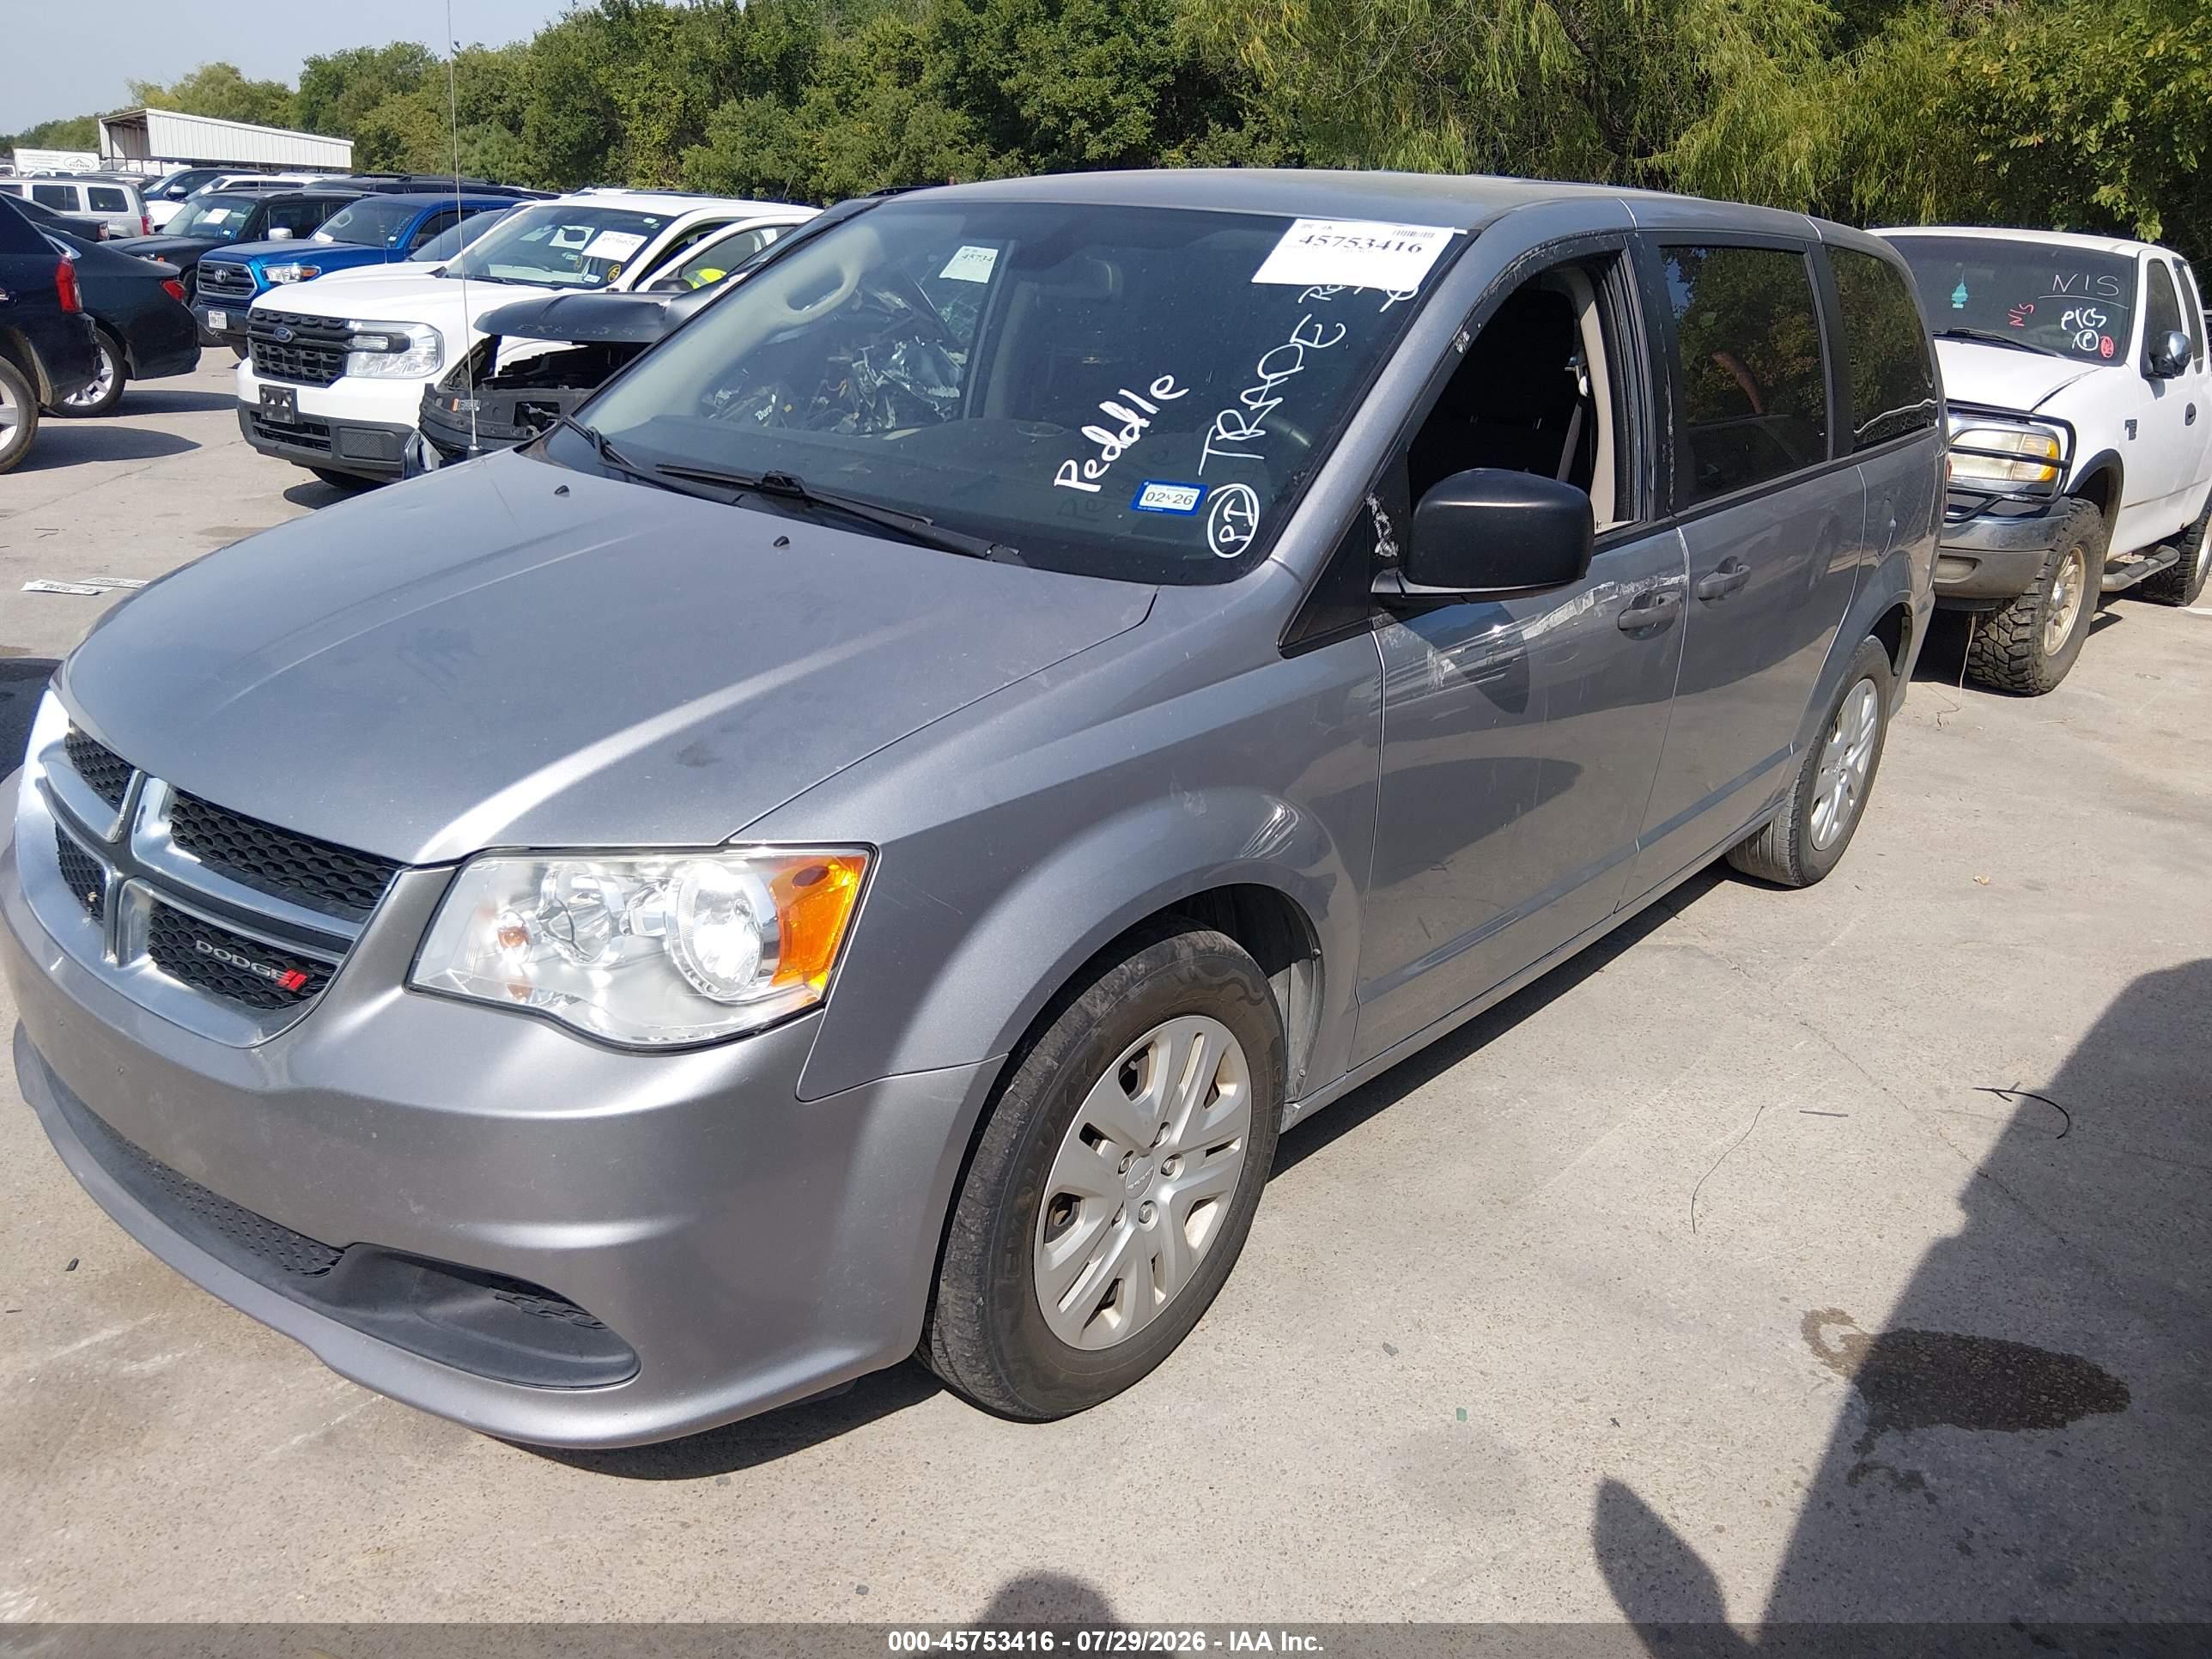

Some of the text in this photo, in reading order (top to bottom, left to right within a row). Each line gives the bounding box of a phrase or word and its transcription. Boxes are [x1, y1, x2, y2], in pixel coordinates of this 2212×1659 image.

[1297, 234, 1423, 254] 45753416
[2051, 273, 2120, 297] NIS
[1198, 313, 1346, 477] TRADE
[1145, 491, 1194, 506] 02 26
[196, 939, 286, 981] DODGE
